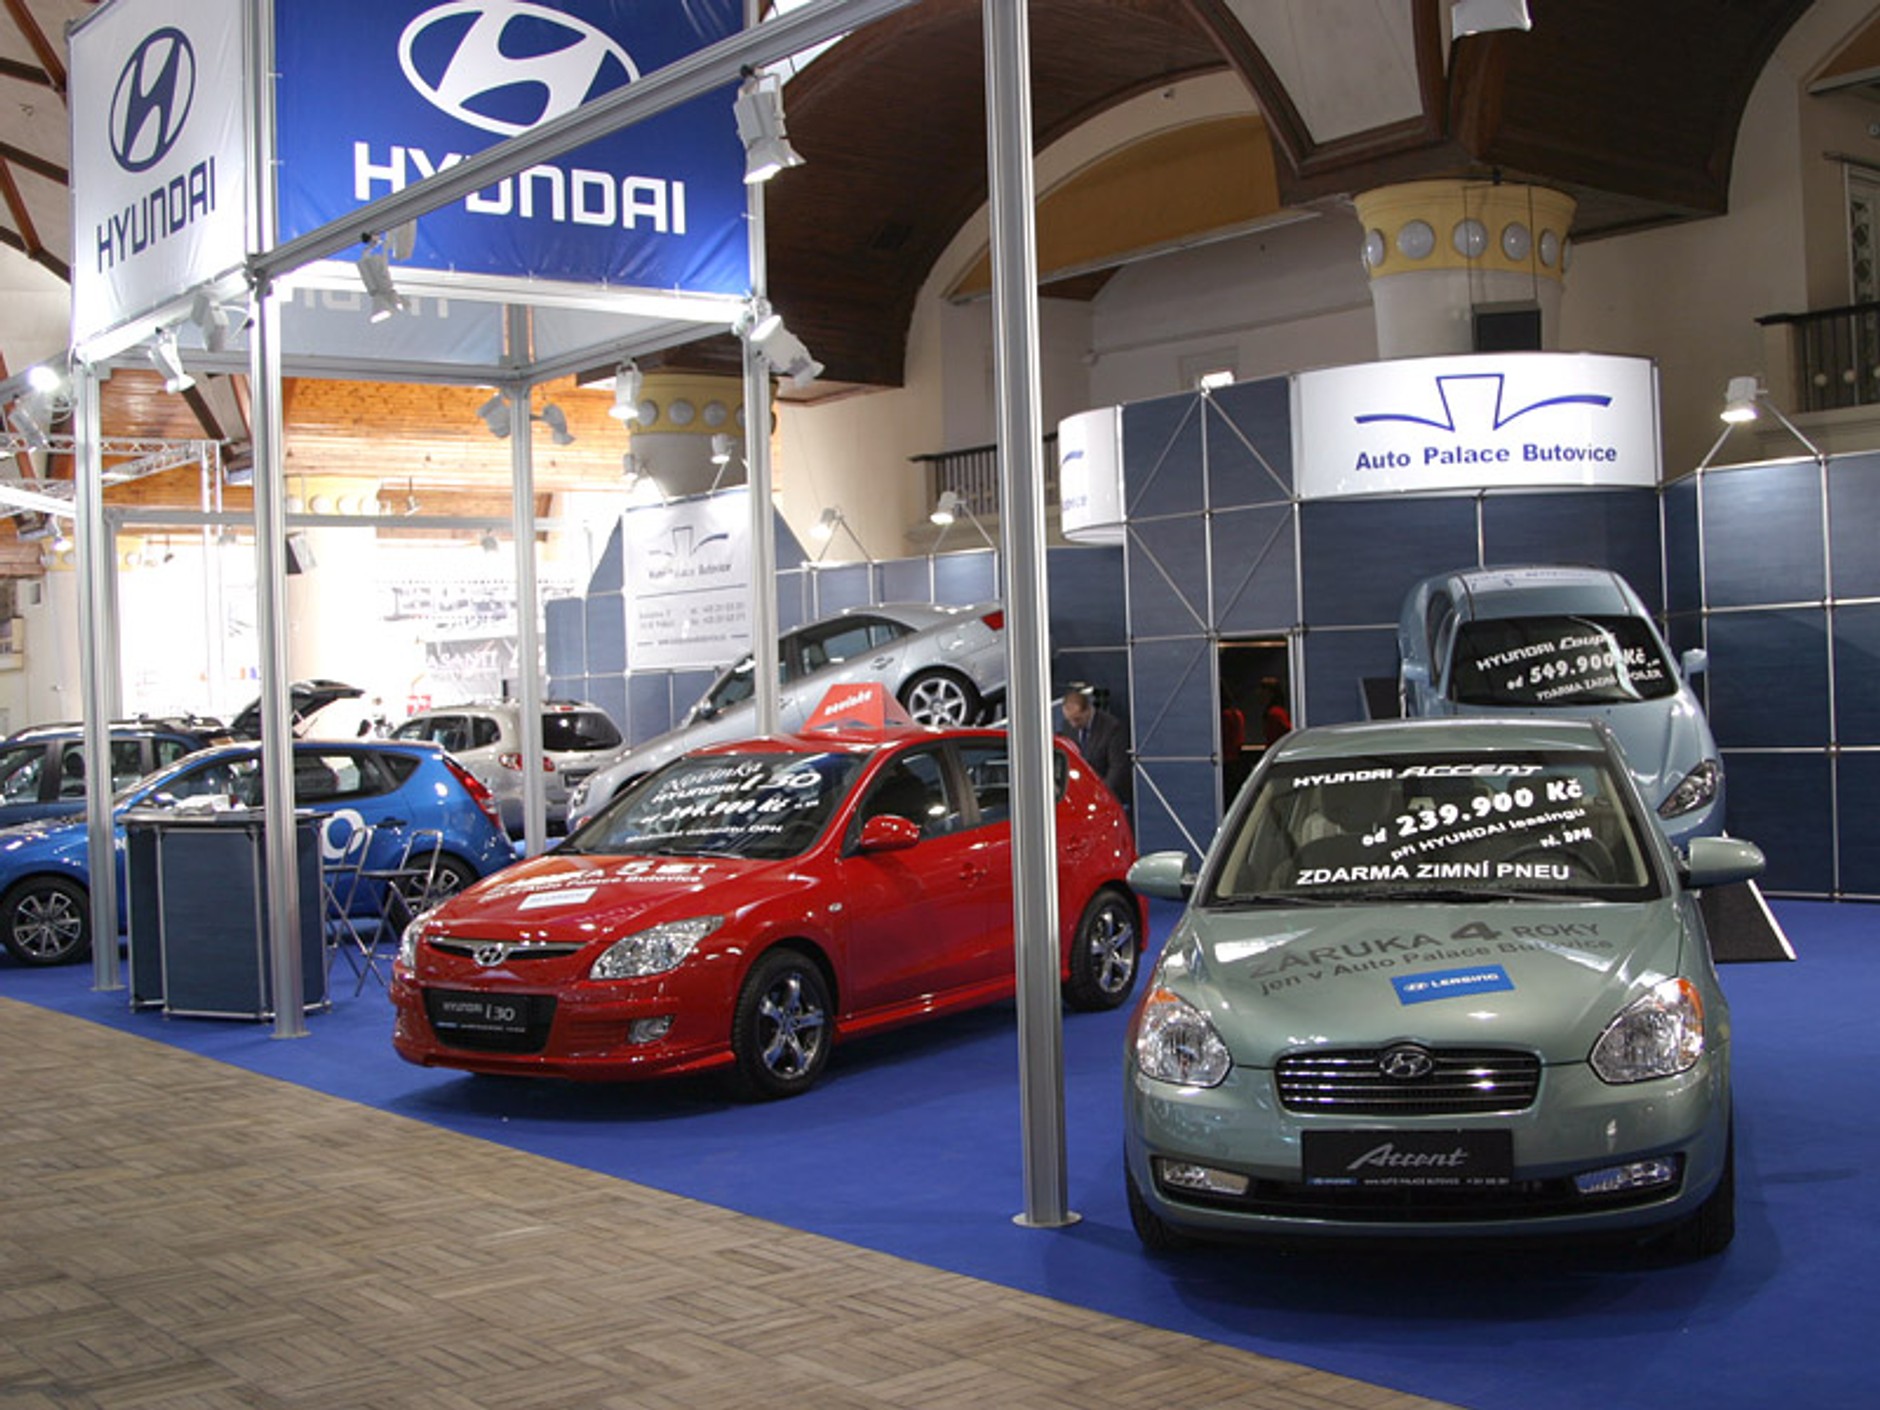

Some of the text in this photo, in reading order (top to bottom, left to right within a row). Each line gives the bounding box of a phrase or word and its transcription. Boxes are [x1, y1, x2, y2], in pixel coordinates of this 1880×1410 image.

[353, 141, 686, 235] HYUNDAI
[97, 155, 215, 273] HYUNDAI
[1355, 443, 1618, 471] Auto Palace Butovice
[1476, 641, 1555, 672] HYUNDAI
[1506, 676, 1524, 691] od
[1528, 652, 1614, 685] 549.900
[1293, 765, 1543, 788] HYUNDAI ACCENT
[1362, 778, 1583, 847] od 239.900 Kč
[1419, 821, 1507, 852] HYUNDAI
[1509, 808, 1586, 831] leasingu
[1296, 860, 1570, 885] ZDARMA ZIMNÍ PNEU
[1451, 921, 1502, 942] 4
[1511, 923, 1602, 938] ROKY
[1260, 938, 1615, 997] jen v Auto Palace Butovice
[1431, 972, 1500, 989] LEASING
[1347, 1142, 1468, 1171] Accent
